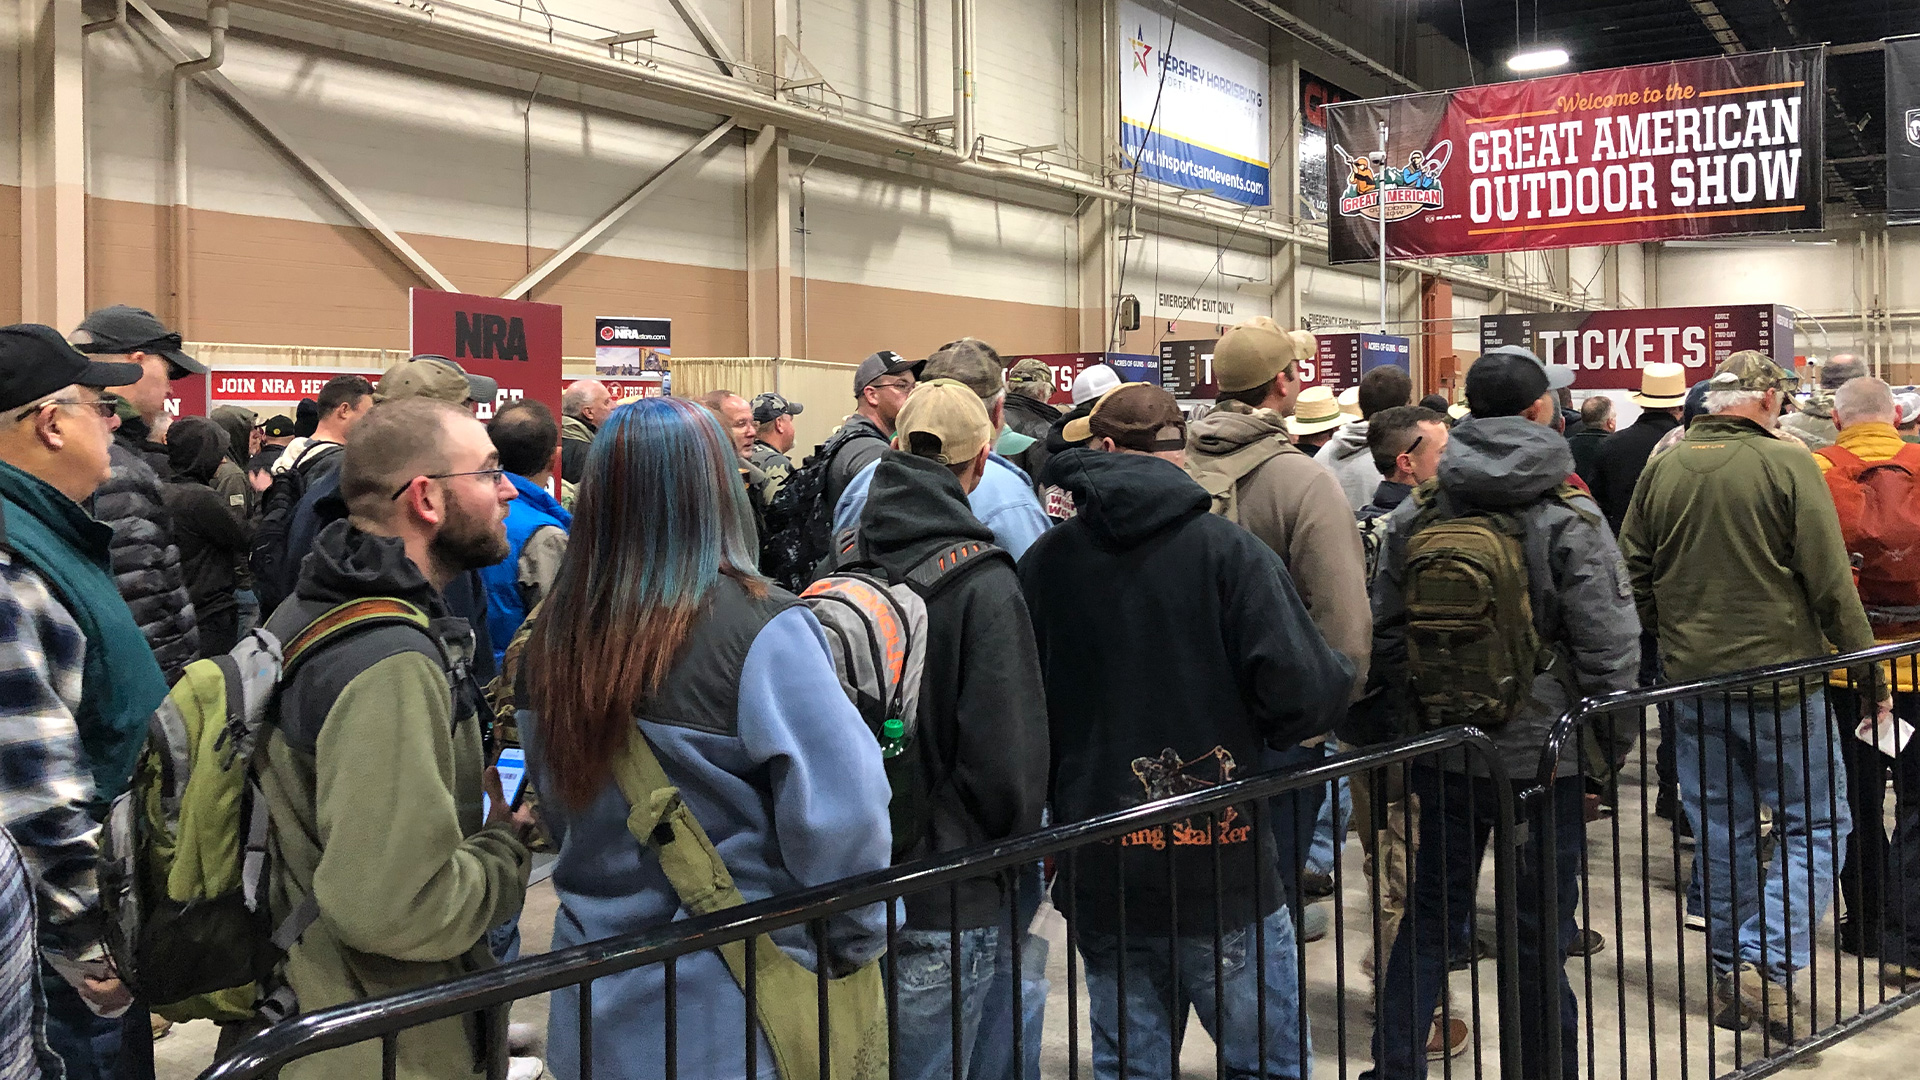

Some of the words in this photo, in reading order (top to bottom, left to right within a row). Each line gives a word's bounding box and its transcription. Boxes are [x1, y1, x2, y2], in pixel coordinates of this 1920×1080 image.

[1157, 50, 1205, 84] HERSHEY
[1206, 71, 1263, 108] HARRISBURG
[1558, 90, 1641, 114] Welcome
[1643, 87, 1664, 104] to
[1665, 82, 1696, 102] the
[1468, 120, 1583, 174] GREAT
[1591, 96, 1801, 162] AMERICAN
[1343, 193, 1378, 212] GREAT
[1384, 189, 1440, 204] MERICAN
[1469, 161, 1658, 224] OUTDOOR
[1670, 148, 1801, 207] SHOW
[1159, 293, 1201, 311] EMERGENCY
[1202, 299, 1216, 313] EXIT
[1217, 301, 1234, 315] ONLY
[1309, 313, 1338, 326] EMERGENCY
[455, 311, 529, 361] NRA
[1538, 326, 1706, 370] TICKETS
[217, 378, 256, 393] JOIN
[262, 378, 295, 394] NRA
[624, 386, 644, 398] FREE
